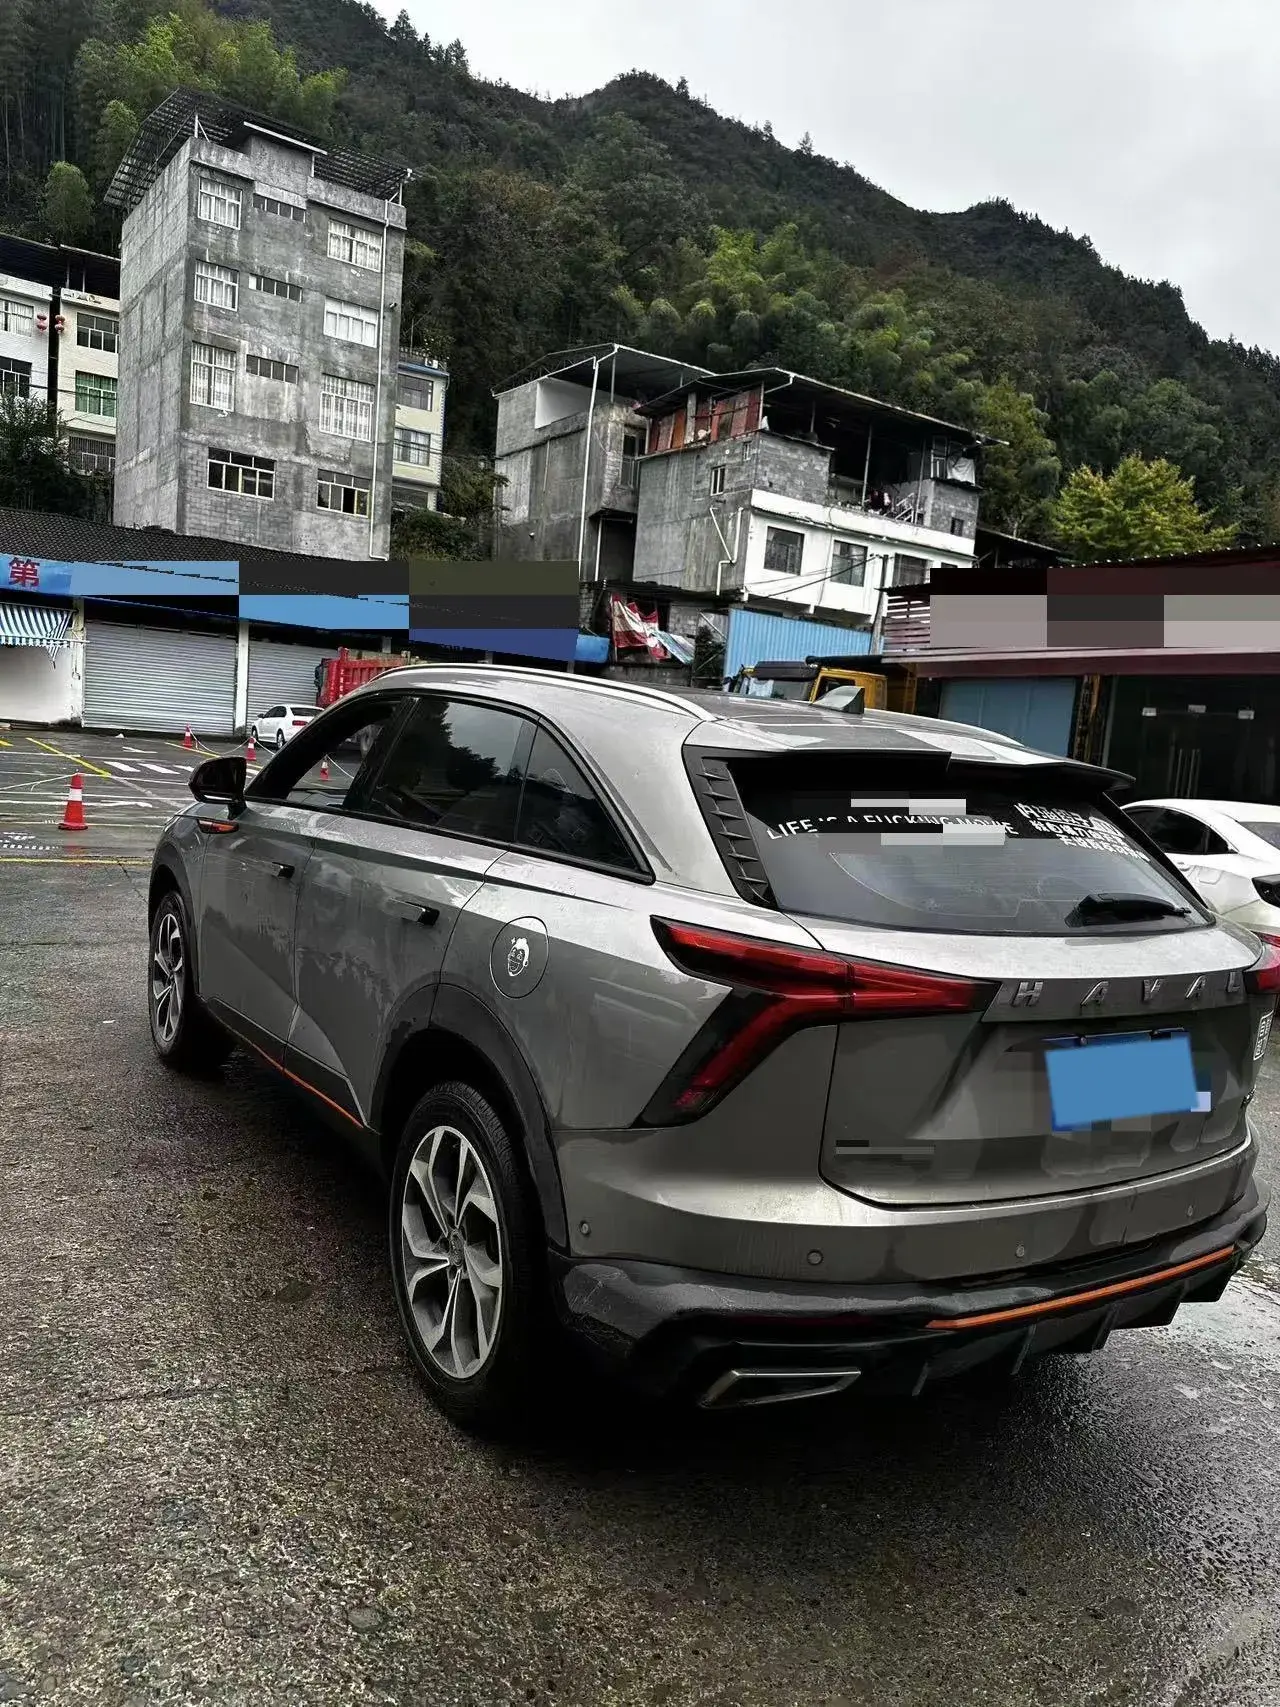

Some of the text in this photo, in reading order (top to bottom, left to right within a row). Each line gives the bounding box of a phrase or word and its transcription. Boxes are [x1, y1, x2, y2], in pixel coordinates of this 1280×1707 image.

[9, 557, 41, 587] 第
[766, 819, 818, 839] LIFE
[1012, 971, 1243, 1007] HAVAL
